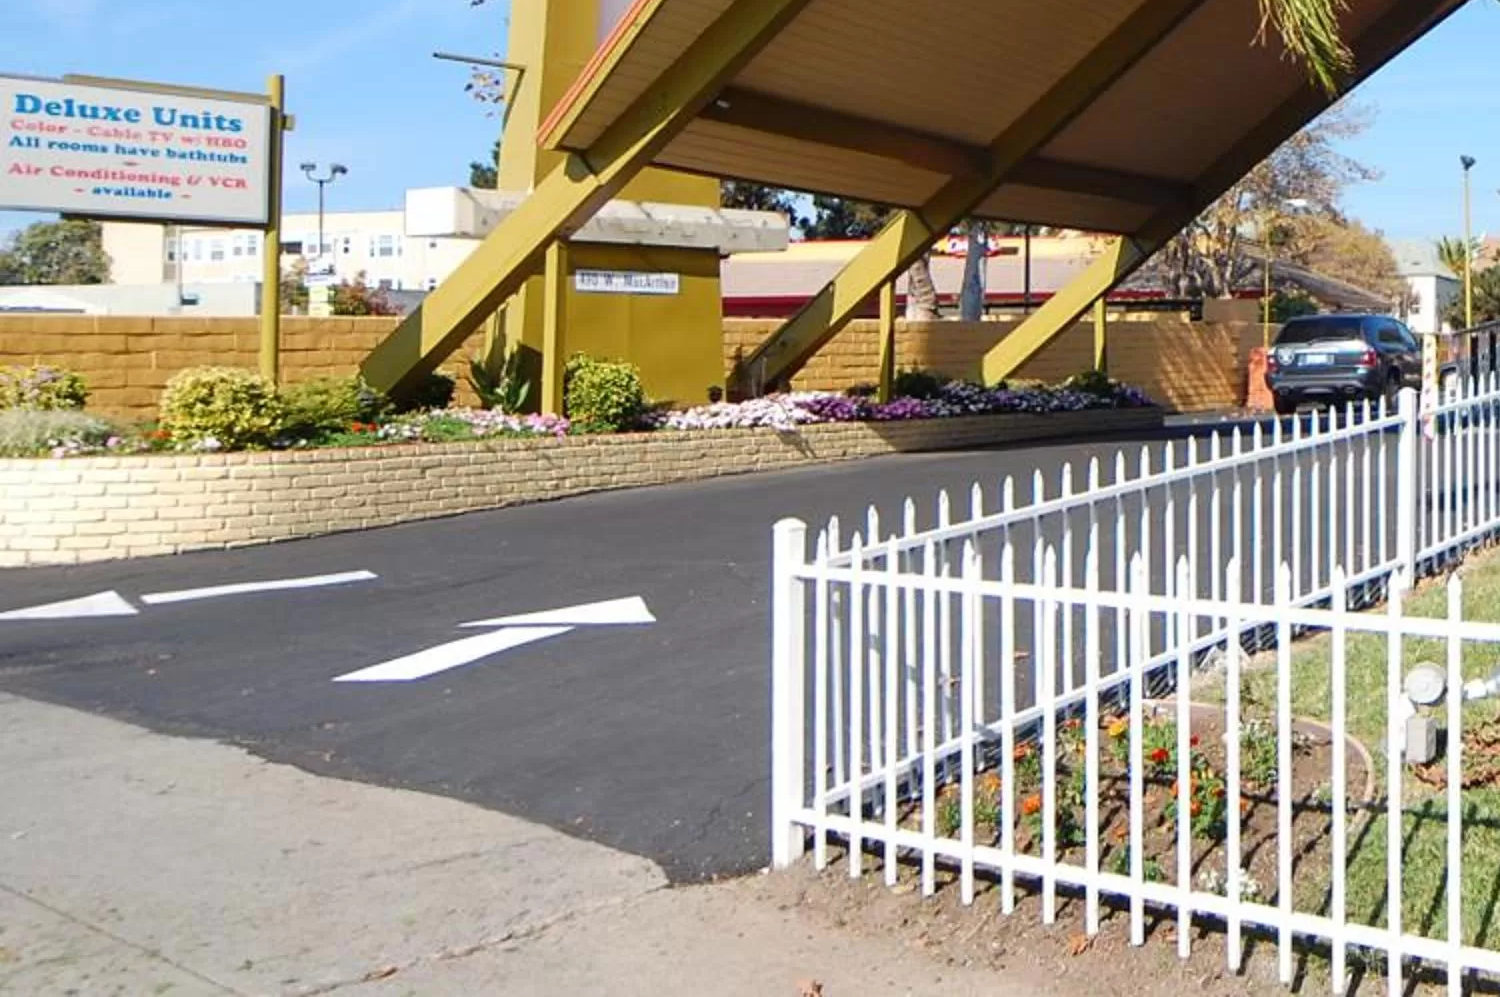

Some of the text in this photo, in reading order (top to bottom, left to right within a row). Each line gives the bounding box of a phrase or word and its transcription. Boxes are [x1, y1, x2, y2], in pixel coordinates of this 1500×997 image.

[14, 93, 243, 132] Deluxe Units
[10, 118, 68, 133] Color
[86, 125, 142, 141] Cable
[148, 131, 174, 142] TV
[206, 136, 247, 149] HBO
[8, 135, 248, 164] All rooms have bathtubs
[8, 162, 247, 189] Air Conditioning & VCR
[92, 186, 173, 200] available
